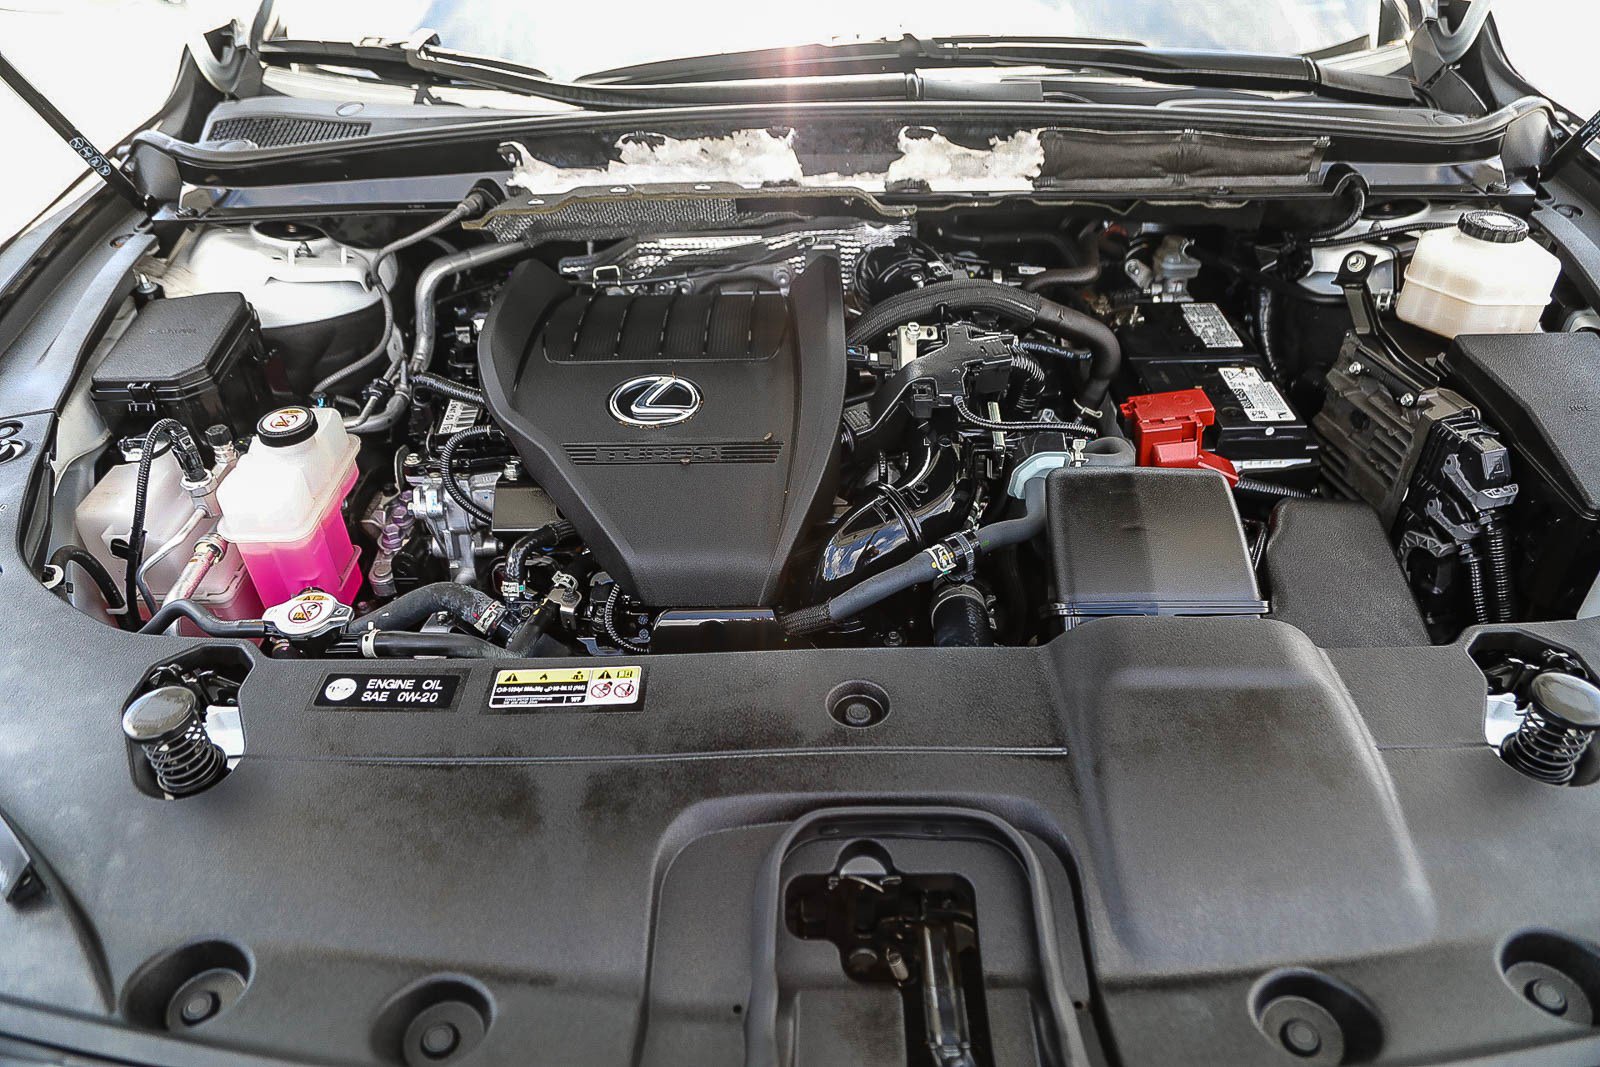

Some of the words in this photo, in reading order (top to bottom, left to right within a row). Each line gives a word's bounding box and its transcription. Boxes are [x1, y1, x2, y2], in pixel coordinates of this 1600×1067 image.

[597, 446, 721, 460] TURBO
[366, 678, 416, 690] ENGINE
[421, 679, 443, 690] OIL
[361, 691, 390, 702] SAE
[397, 692, 439, 703] 0W-20
